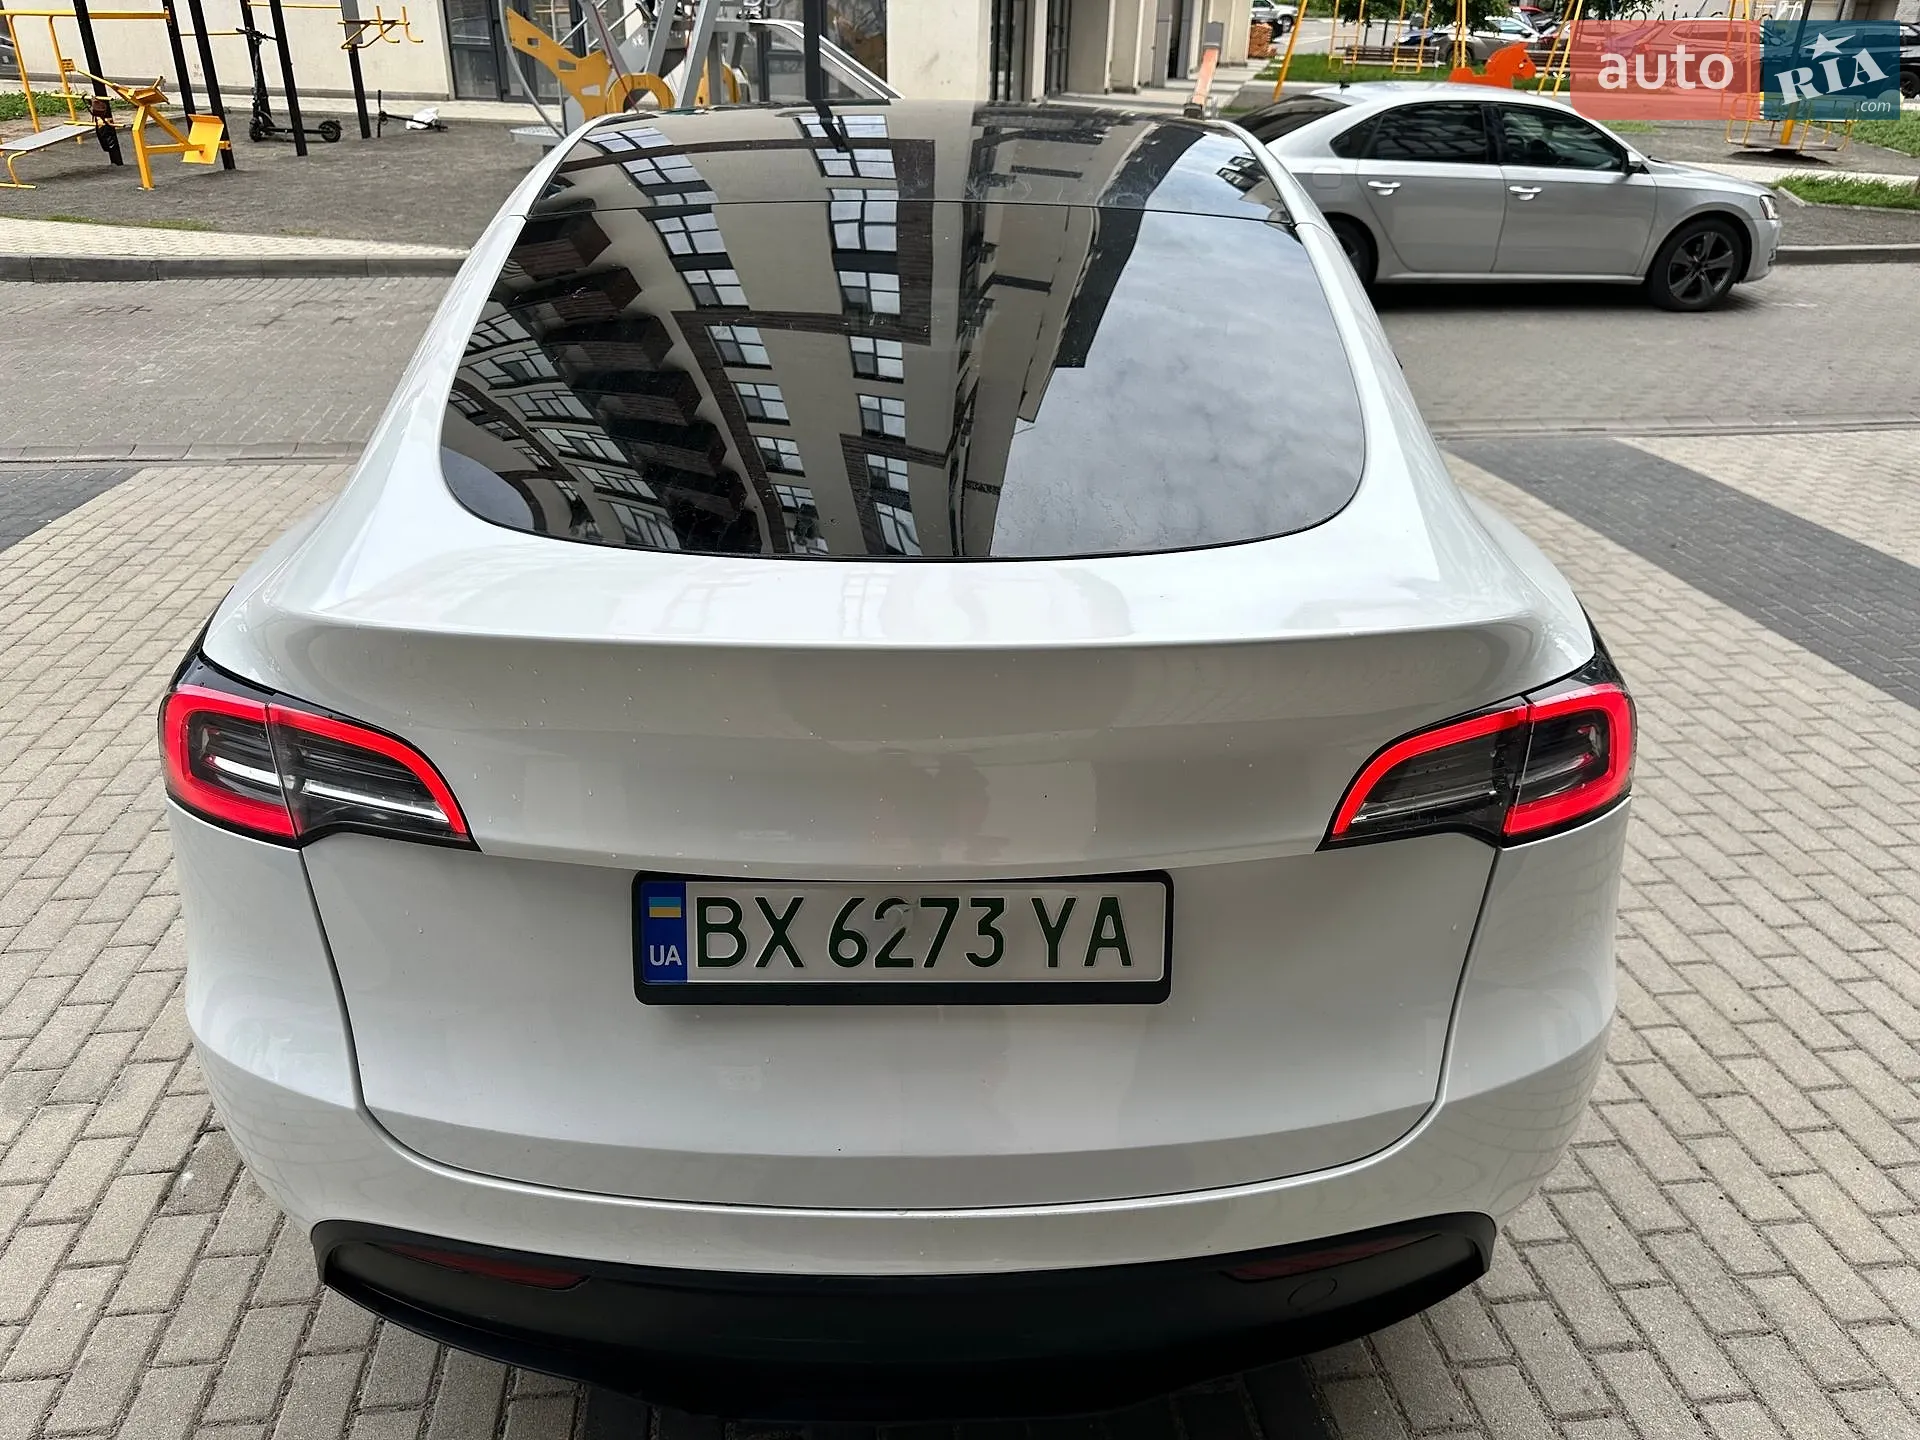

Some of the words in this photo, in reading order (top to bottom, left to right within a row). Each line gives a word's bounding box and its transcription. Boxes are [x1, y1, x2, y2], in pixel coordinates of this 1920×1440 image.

[649, 945, 682, 966] UA
[696, 896, 805, 969] BX
[828, 896, 1005, 969] 6273
[1030, 896, 1132, 969] YA
